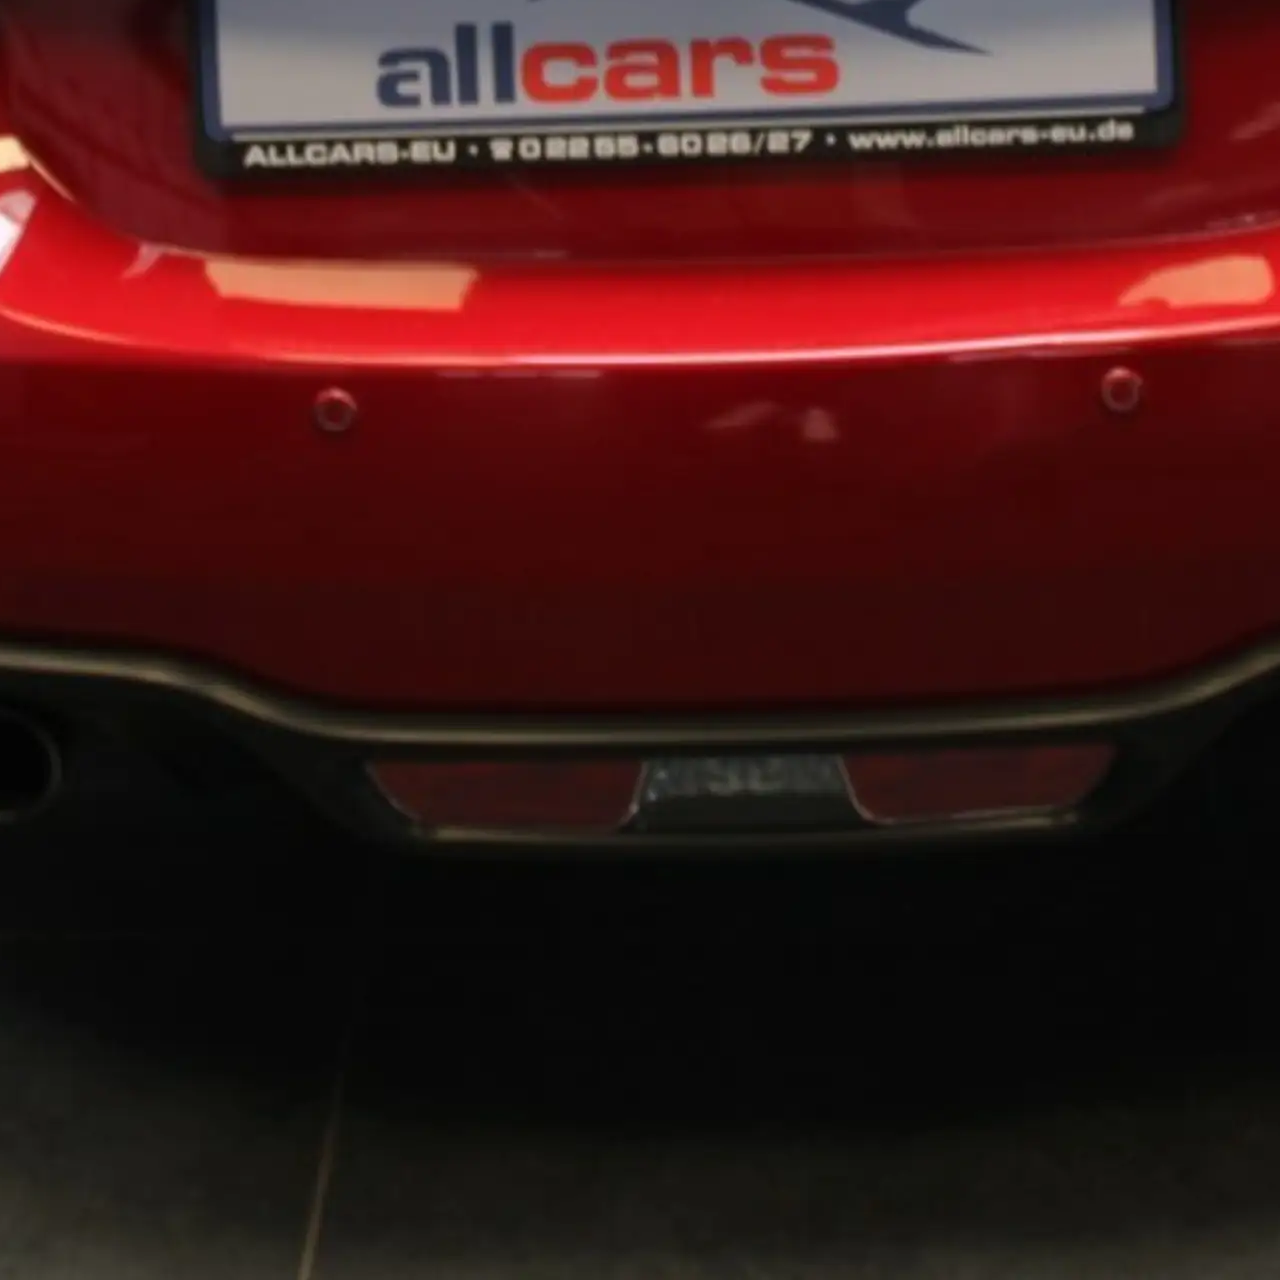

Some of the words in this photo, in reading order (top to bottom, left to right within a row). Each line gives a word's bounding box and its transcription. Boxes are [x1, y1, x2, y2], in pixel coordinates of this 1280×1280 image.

[375, 22, 840, 109] allcars
[243, 138, 457, 169] ALLCARS-EU
[847, 120, 1134, 151] www.allcars-eu.de
